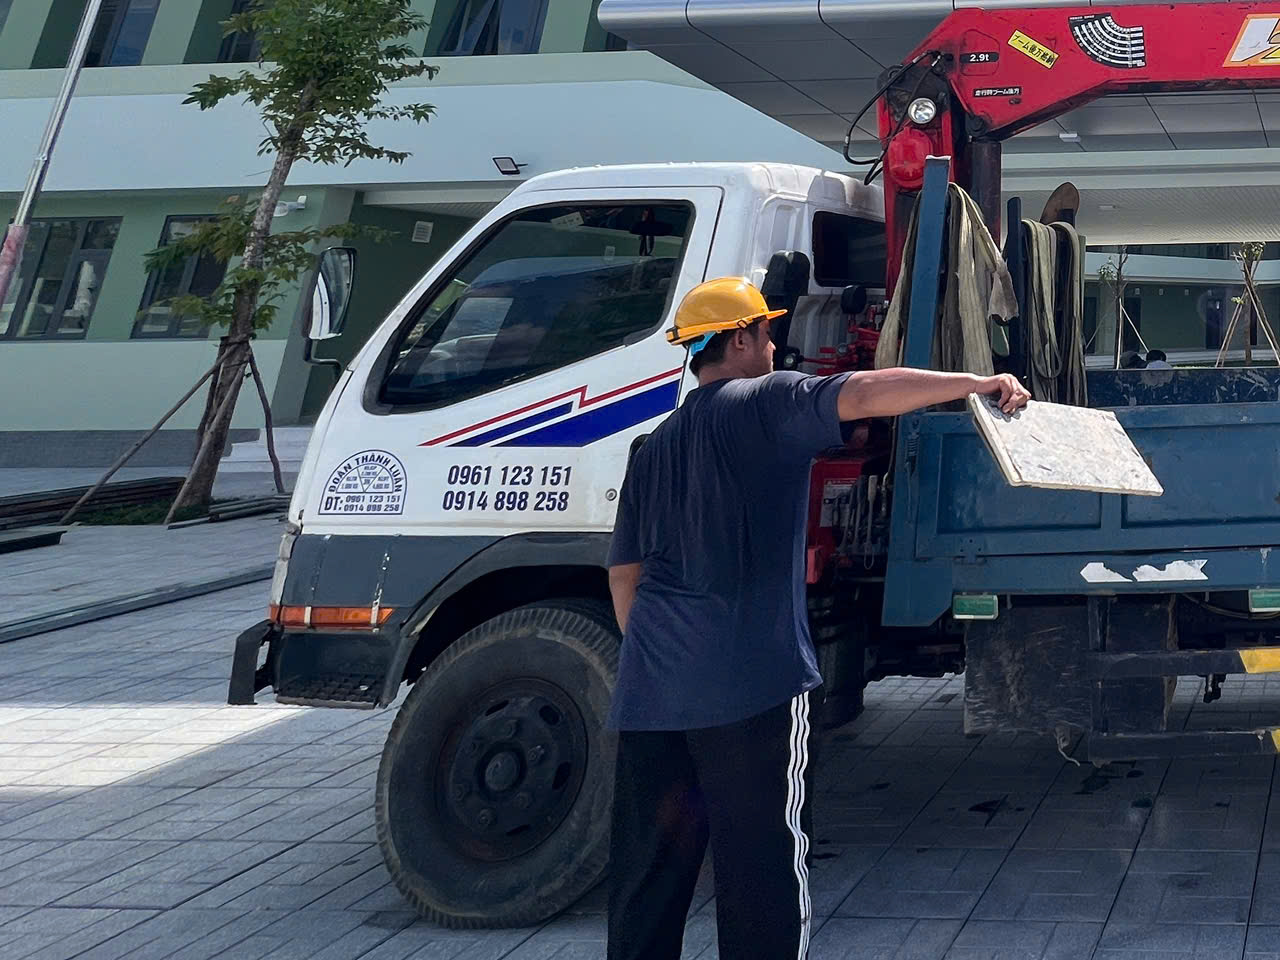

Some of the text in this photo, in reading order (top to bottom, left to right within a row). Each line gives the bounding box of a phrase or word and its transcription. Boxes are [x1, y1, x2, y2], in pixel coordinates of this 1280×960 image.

[969, 53, 990, 62] 2.9t
[447, 465, 572, 486] 0961 123 151
[369, 495, 384, 503] 123
[386, 495, 401, 503] 151
[442, 490, 570, 512] 0914 898 258
